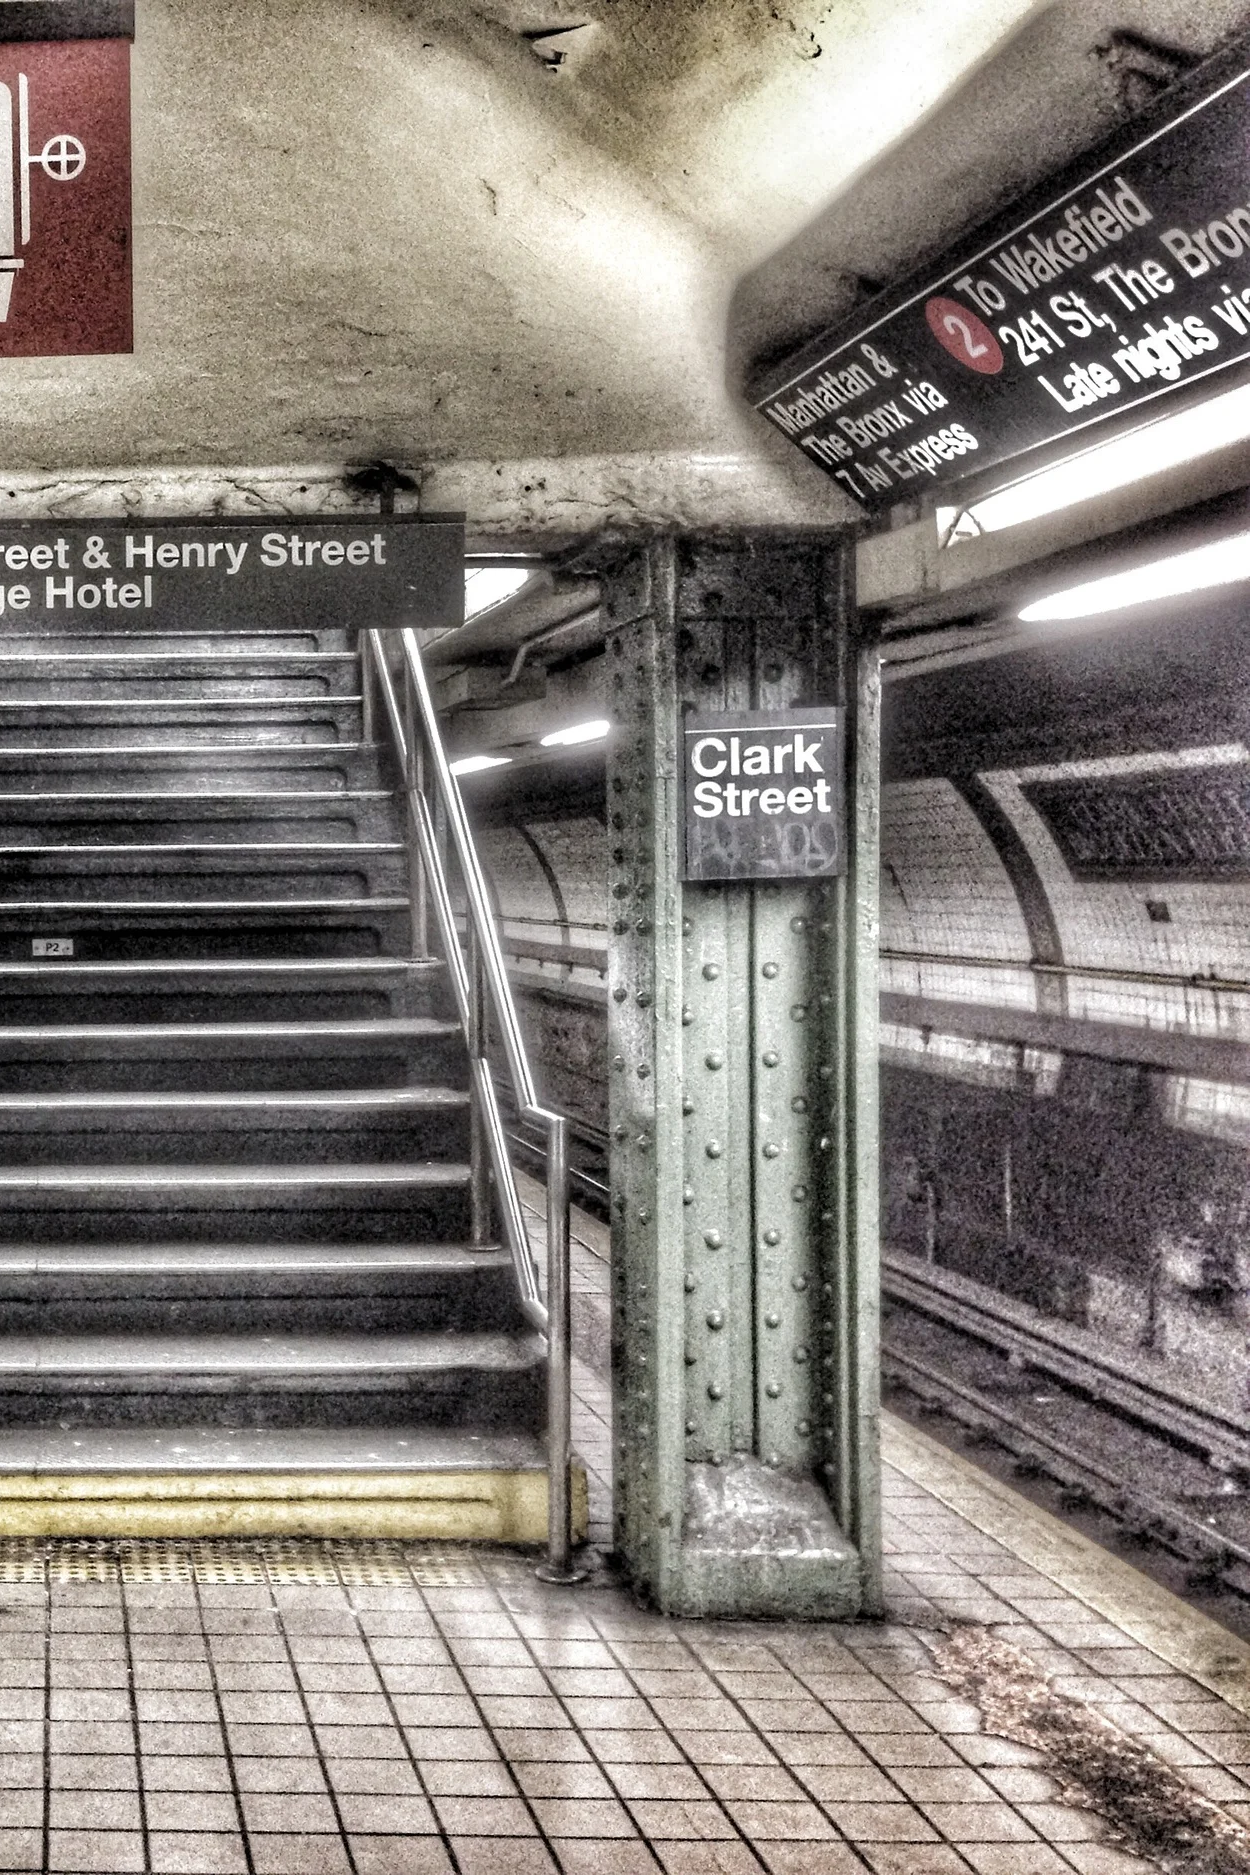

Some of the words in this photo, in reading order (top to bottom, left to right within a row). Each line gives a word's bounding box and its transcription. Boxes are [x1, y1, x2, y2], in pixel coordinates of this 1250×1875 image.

[989, 176, 1153, 294] Wakefield
[953, 275, 1006, 316] To
[998, 309, 1066, 366] 241
[1050, 291, 1117, 338] St,
[1091, 260, 1175, 312] The
[1159, 203, 1250, 278] Bron
[943, 315, 988, 358] 2
[1037, 362, 1121, 413] Late
[1112, 316, 1219, 383] nights
[766, 363, 877, 435] Manhattan
[860, 343, 898, 378] &
[801, 434, 853, 465] The
[836, 400, 914, 448] Bronx
[902, 378, 949, 415] via
[835, 469, 866, 498] 7
[854, 462, 893, 492] Av
[877, 423, 979, 480] Express
[82, 535, 112, 569] &
[125, 535, 248, 575] Henry
[260, 532, 387, 567] Street
[45, 575, 153, 609] Hotel
[691, 734, 824, 778] Clark
[693, 779, 832, 818] Street
[45, 943, 60, 952] P2
